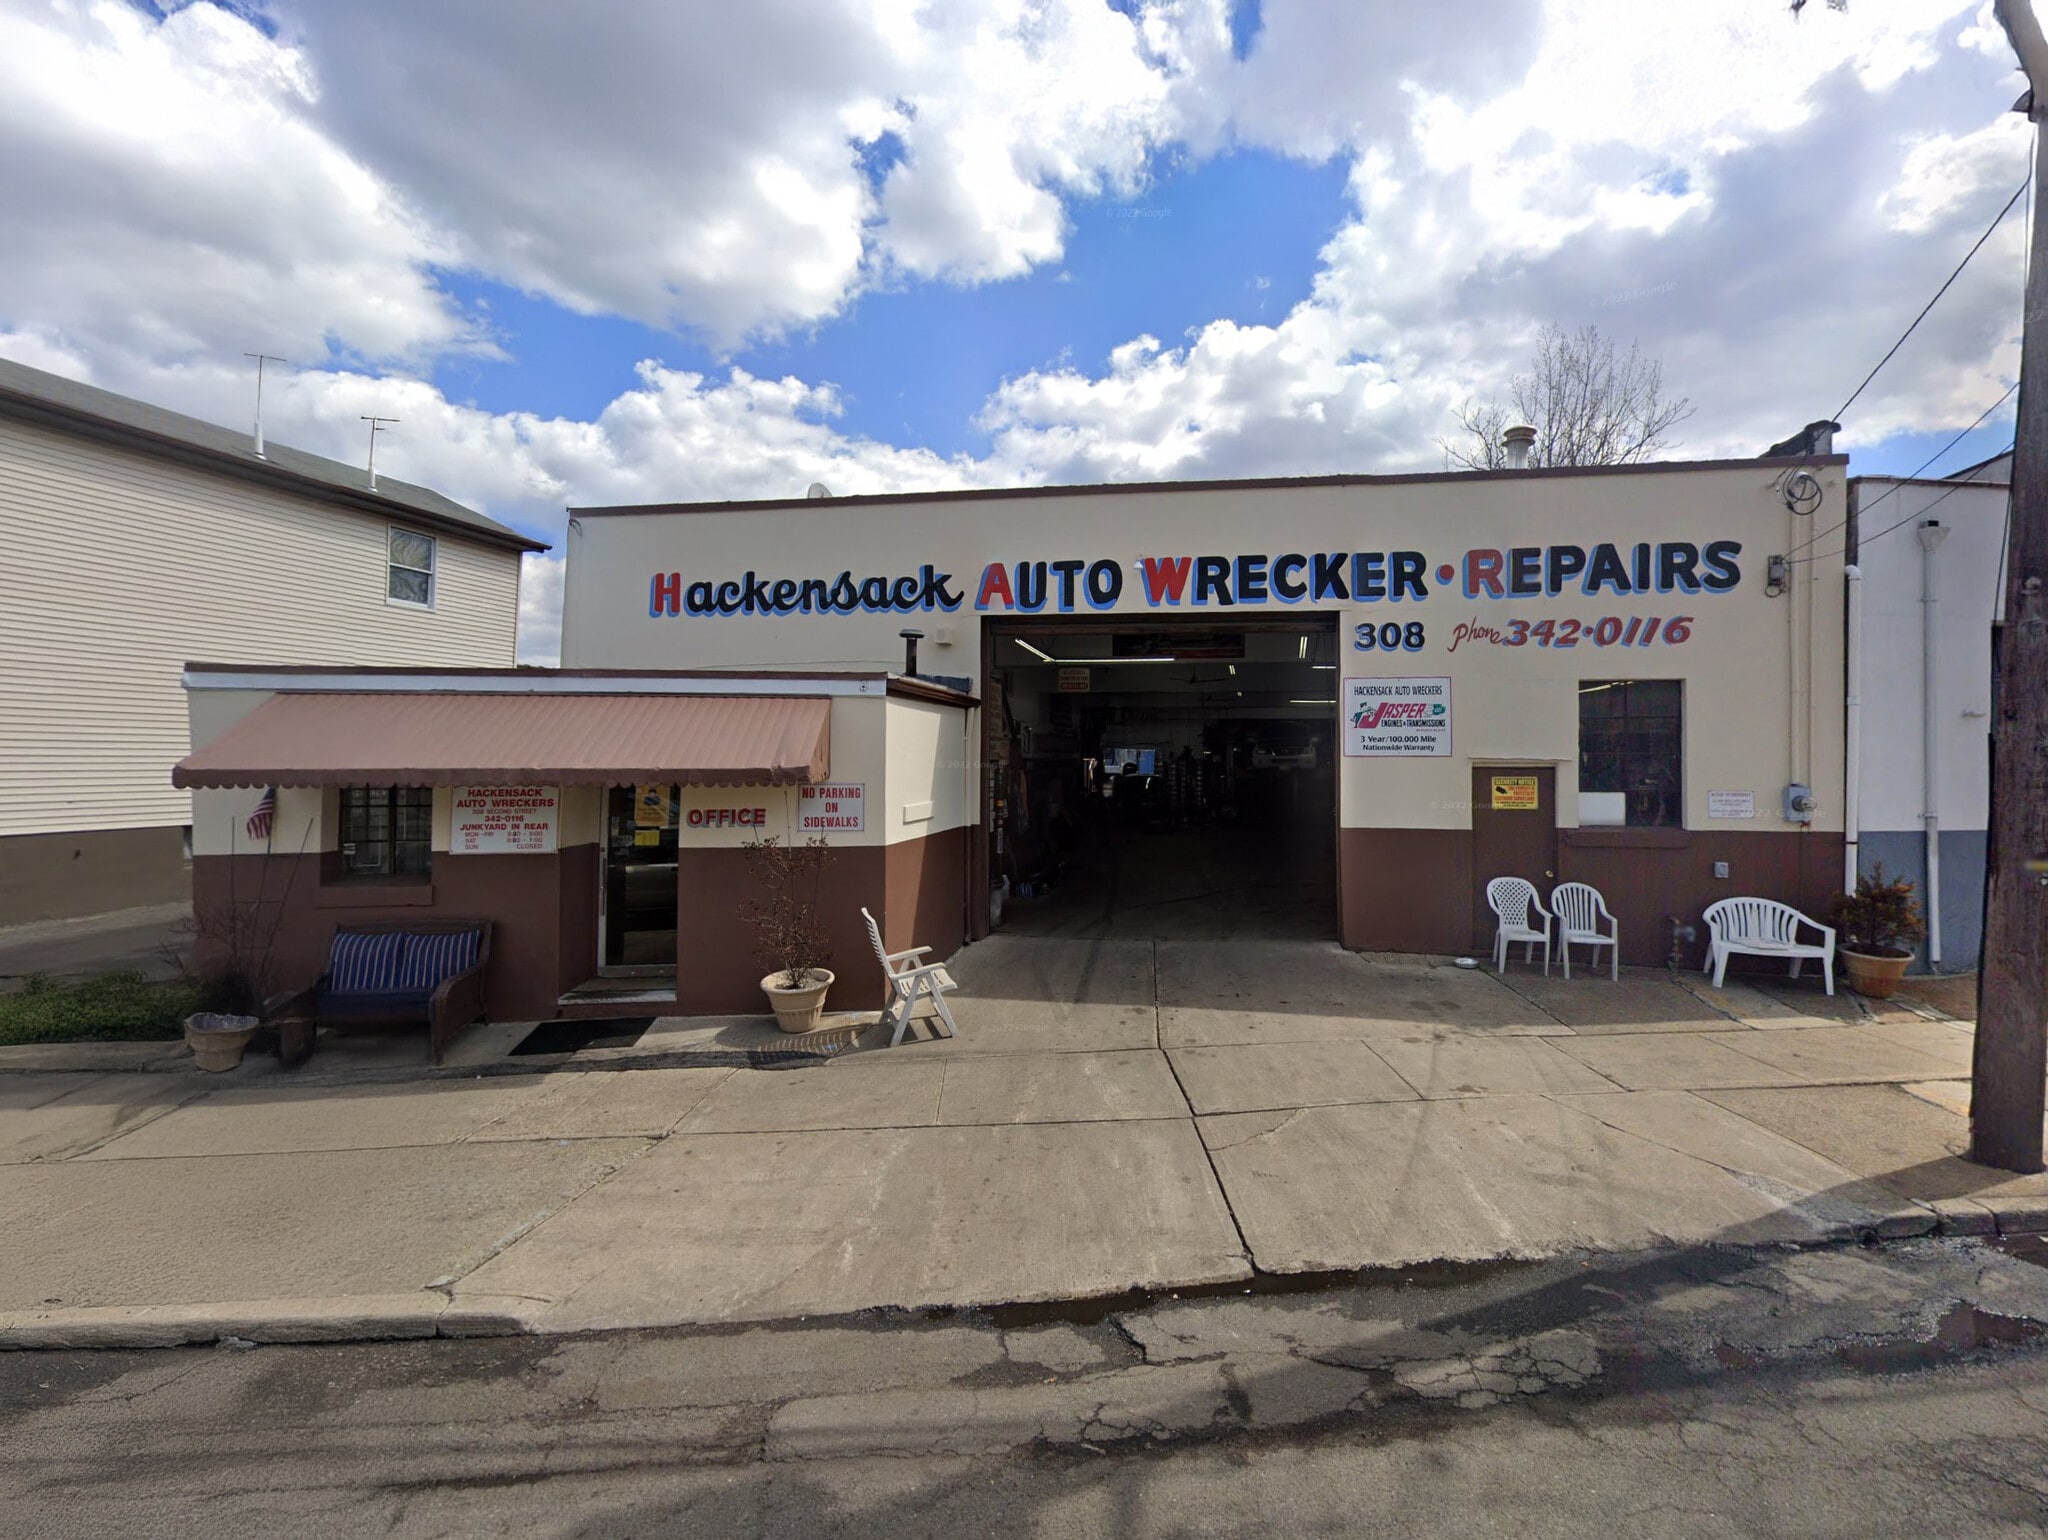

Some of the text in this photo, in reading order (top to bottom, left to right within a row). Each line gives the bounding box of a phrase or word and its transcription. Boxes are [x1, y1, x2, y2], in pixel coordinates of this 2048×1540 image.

[649, 540, 1743, 618] Hackensack AUTO WRECKER REPAIRS
[1354, 622, 1426, 651] 308
[1354, 685, 1443, 696] HACKENSACK AUTO WRECKERS
[1358, 702, 1427, 729] JASPER
[1381, 720, 1403, 728] ENGINES
[1407, 719, 1446, 728] TRANSMISSIONS
[1421, 735, 1437, 743] Mile
[1404, 744, 1435, 753] Warranty
[468, 788, 543, 798] HACKENSACK
[802, 787, 861, 799] NO PARKING
[457, 798, 554, 808] AUTO WRECKERS
[825, 802, 839, 813] ON
[686, 808, 767, 828] OFFICE
[803, 816, 859, 828] SIDEWALKS
[460, 823, 507, 831] JUNKYARD
